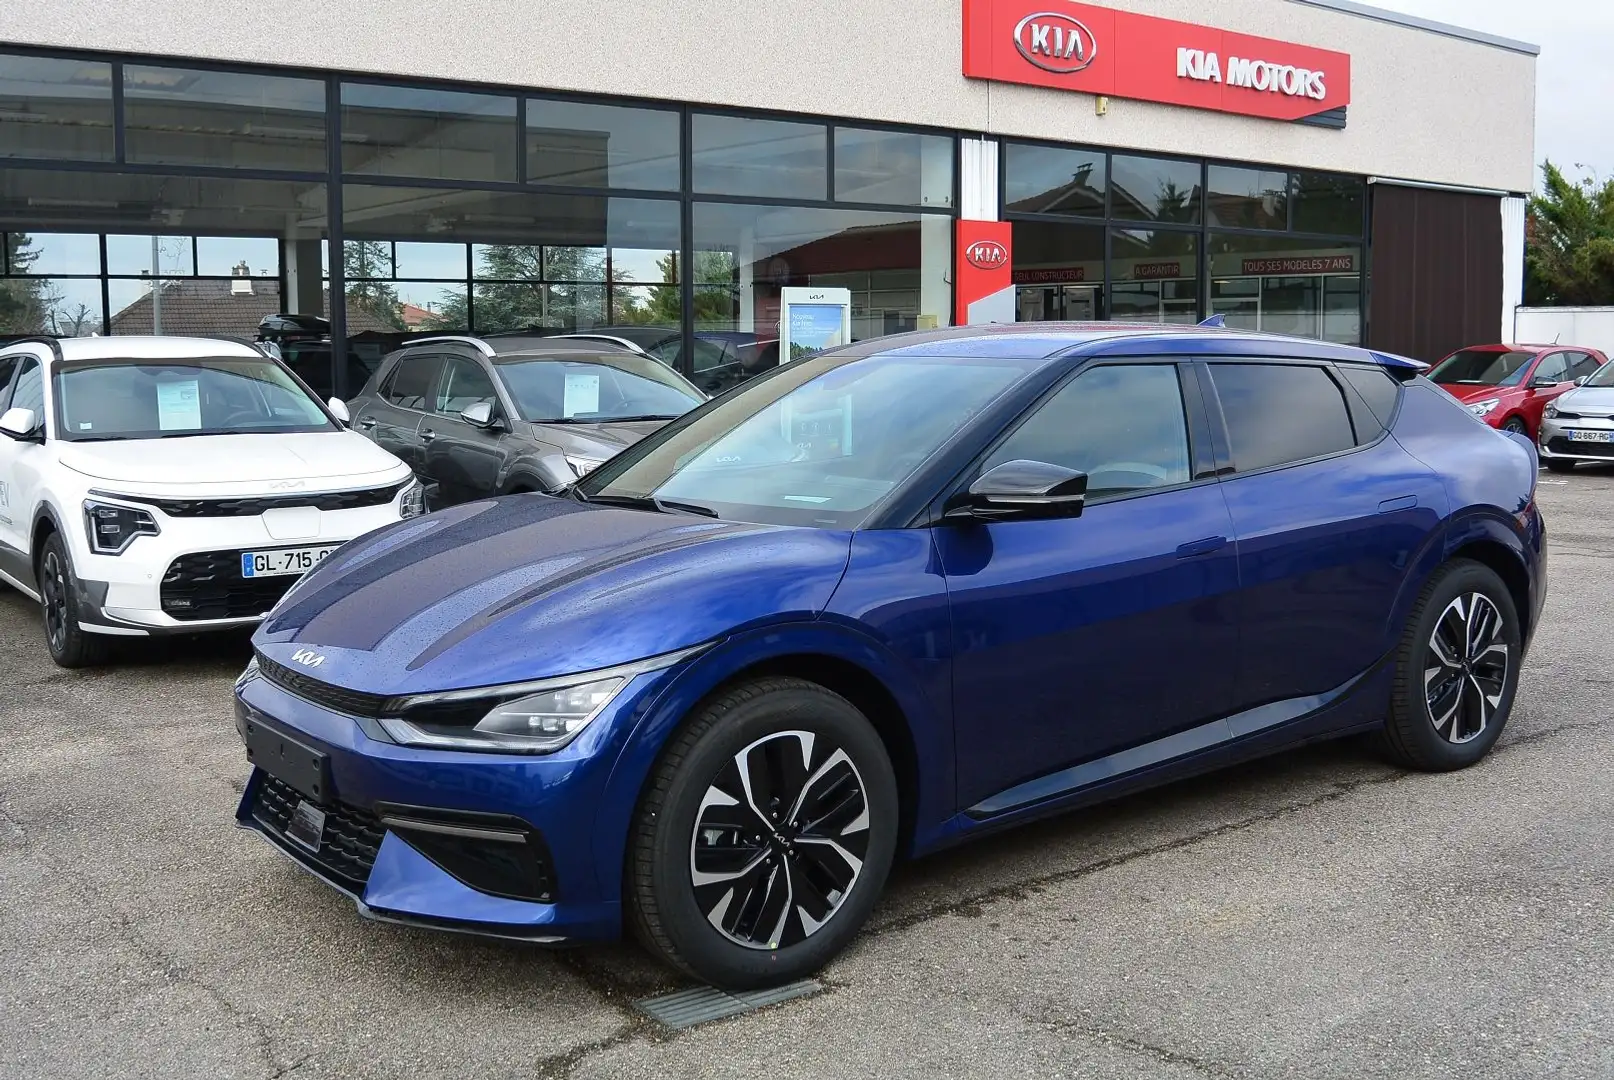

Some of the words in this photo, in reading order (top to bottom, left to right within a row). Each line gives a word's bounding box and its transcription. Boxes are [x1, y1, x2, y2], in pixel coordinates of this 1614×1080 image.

[1030, 23, 1084, 60] KIA
[1176, 47, 1222, 83] KIA
[1226, 56, 1326, 100] MOTORS
[974, 247, 1001, 263] KIA
[1141, 265, 1179, 276] GARANTIR
[1244, 261, 1265, 272] TOUS
[1266, 260, 1281, 271] SES
[1324, 259, 1330, 269] 7
[1332, 258, 1351, 269] ANS
[291, 648, 326, 668] KIA
